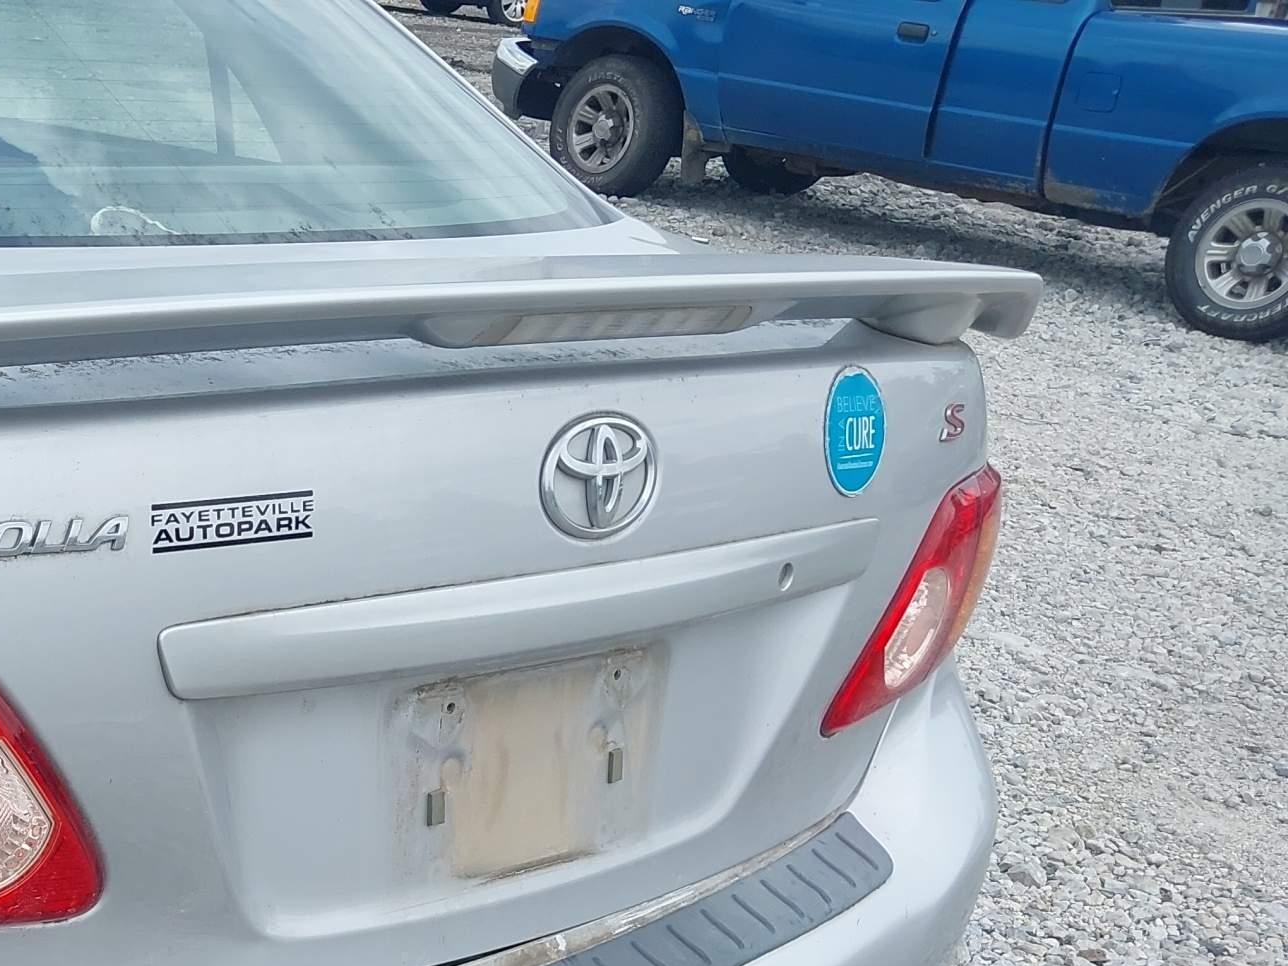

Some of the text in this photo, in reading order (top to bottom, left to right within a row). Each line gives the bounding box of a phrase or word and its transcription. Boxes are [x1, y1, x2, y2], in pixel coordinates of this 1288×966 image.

[1187, 184, 1259, 243] AVENGER
[836, 394, 877, 413] BELIEVE
[845, 416, 875, 451] CURE
[938, 403, 965, 442] S
[150, 498, 315, 527] FAYETTEVILLE
[152, 514, 314, 546] AUTOPARK
